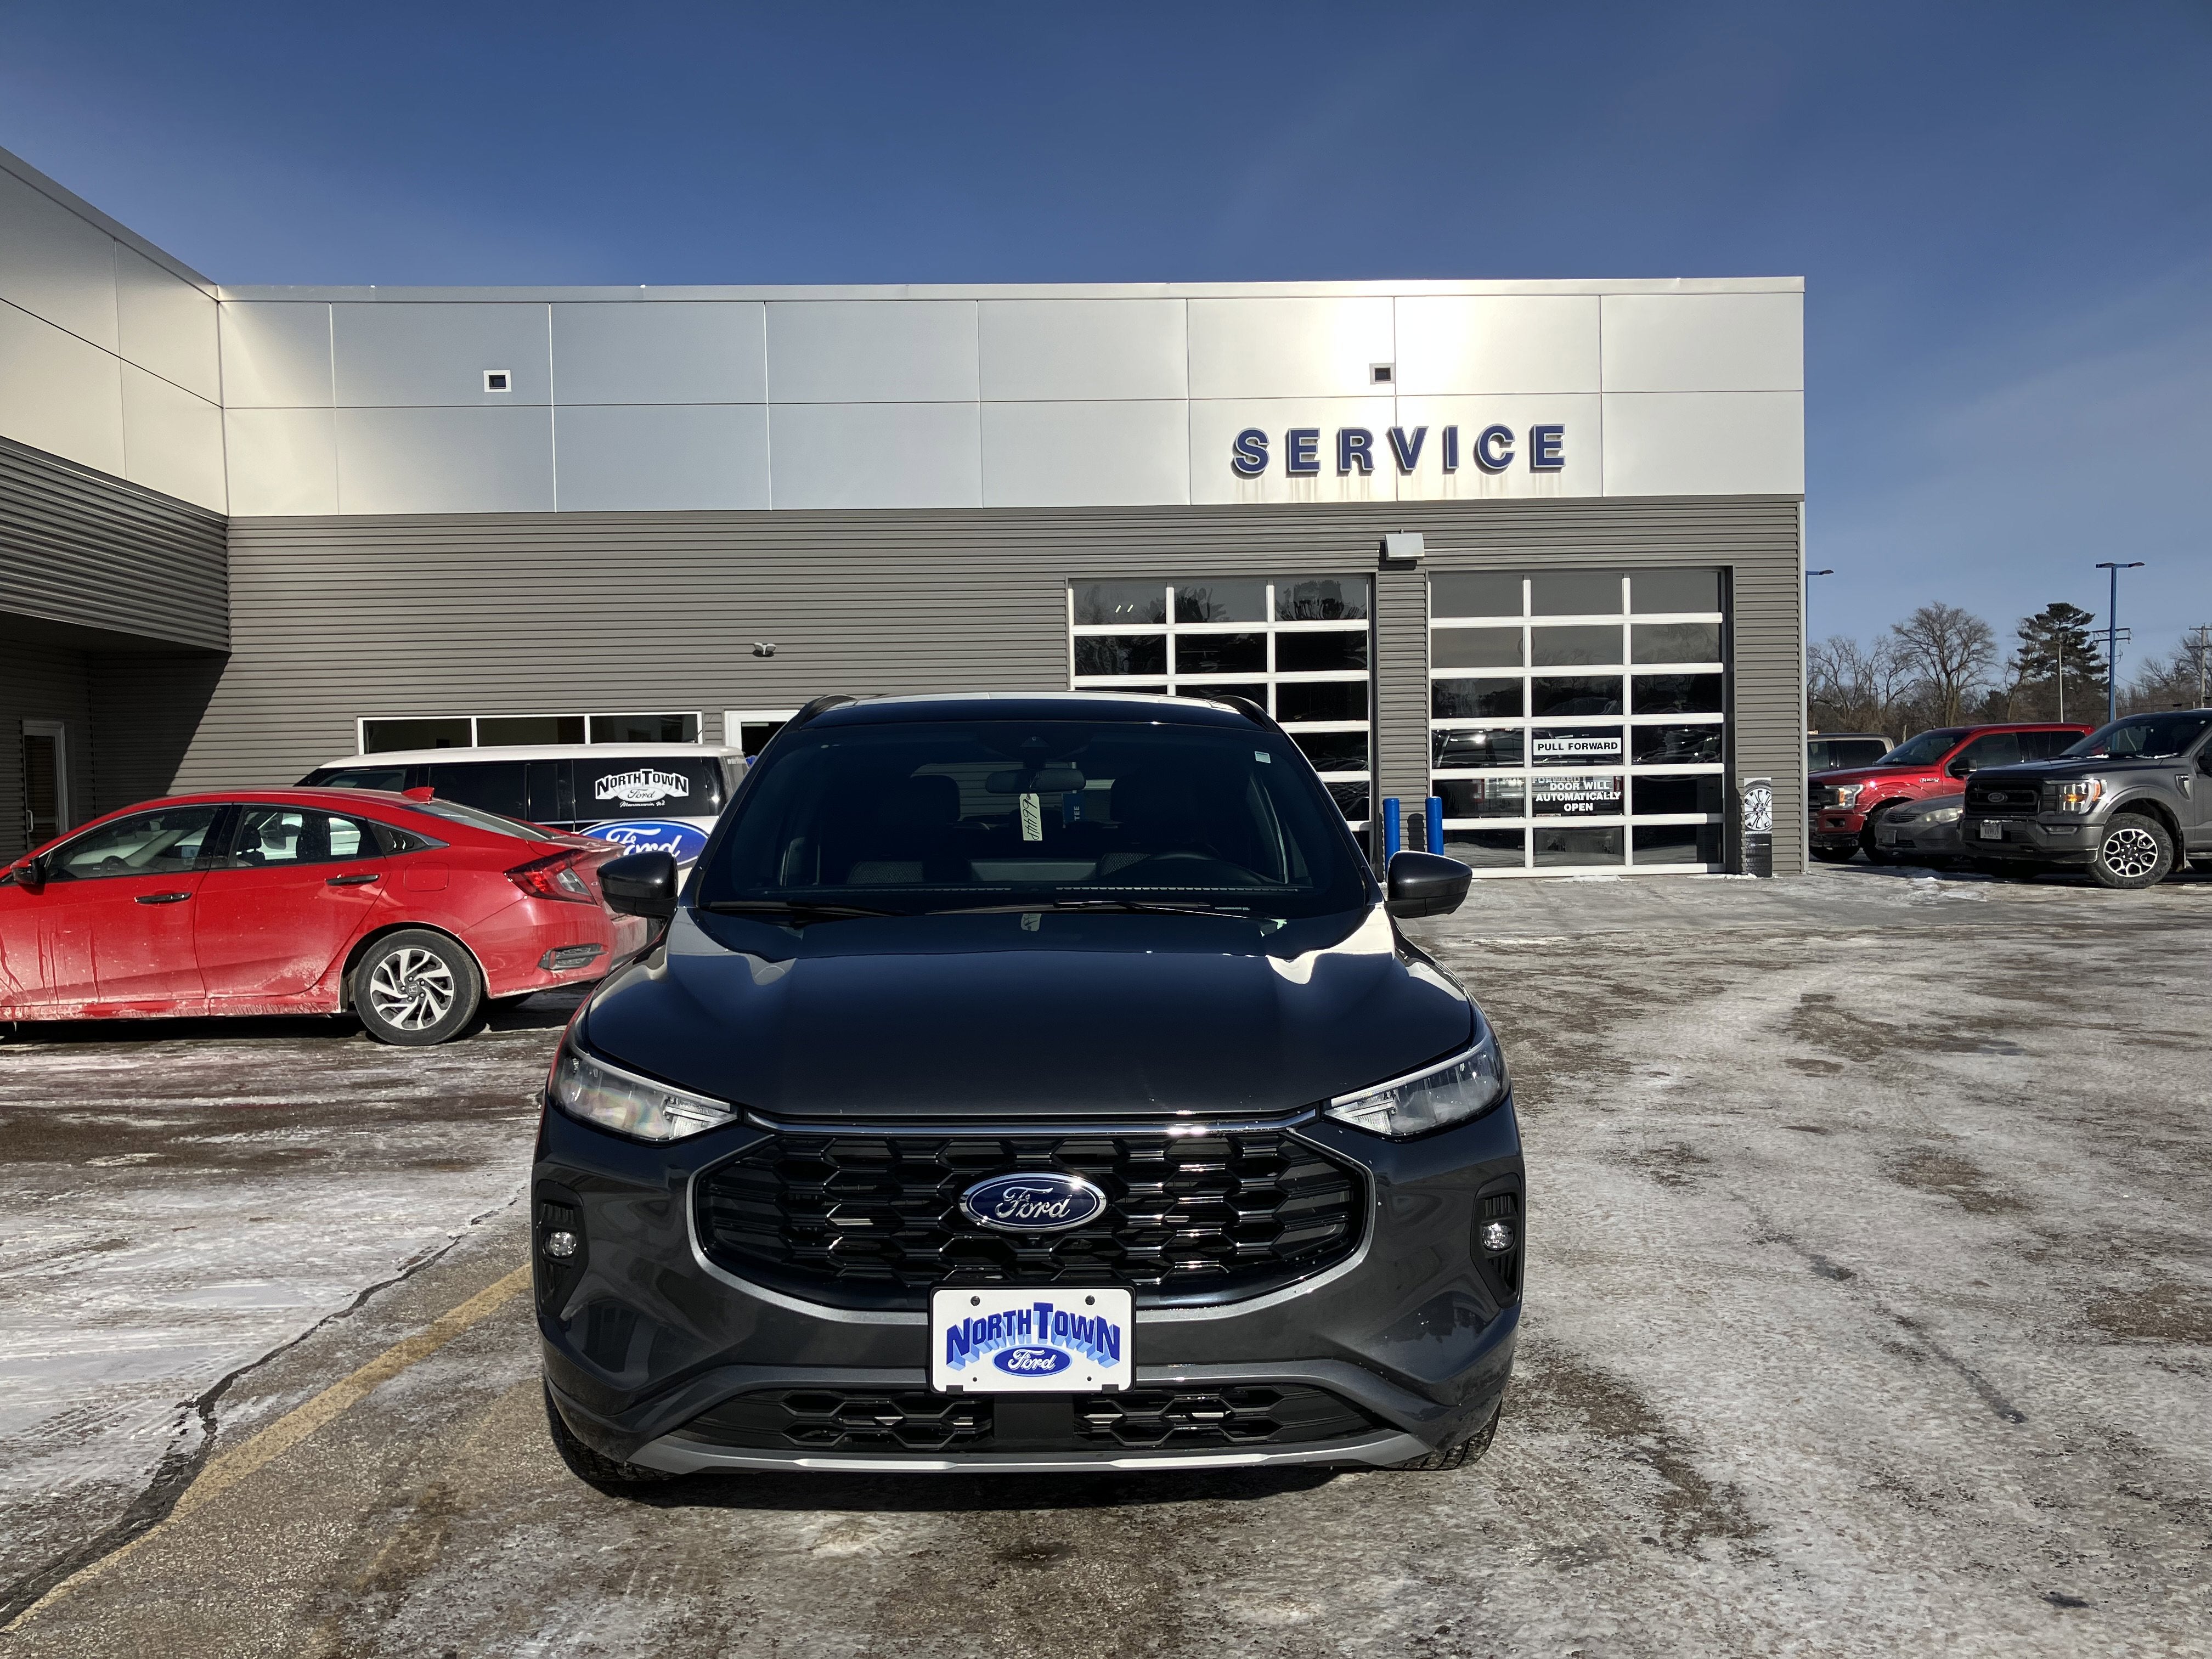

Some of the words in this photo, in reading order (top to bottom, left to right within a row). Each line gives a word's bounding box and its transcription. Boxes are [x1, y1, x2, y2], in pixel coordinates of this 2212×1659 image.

[1231, 424, 1566, 479] SERVICE
[1550, 782, 1580, 791] DOOR
[1583, 781, 1610, 789] WILL
[628, 789, 656, 798] Ford
[1536, 792, 1621, 802] AUTOMATICALLY
[1564, 803, 1593, 811] OPEN
[995, 1186, 1073, 1218] Ford
[1007, 1348, 1057, 1370] Ford
